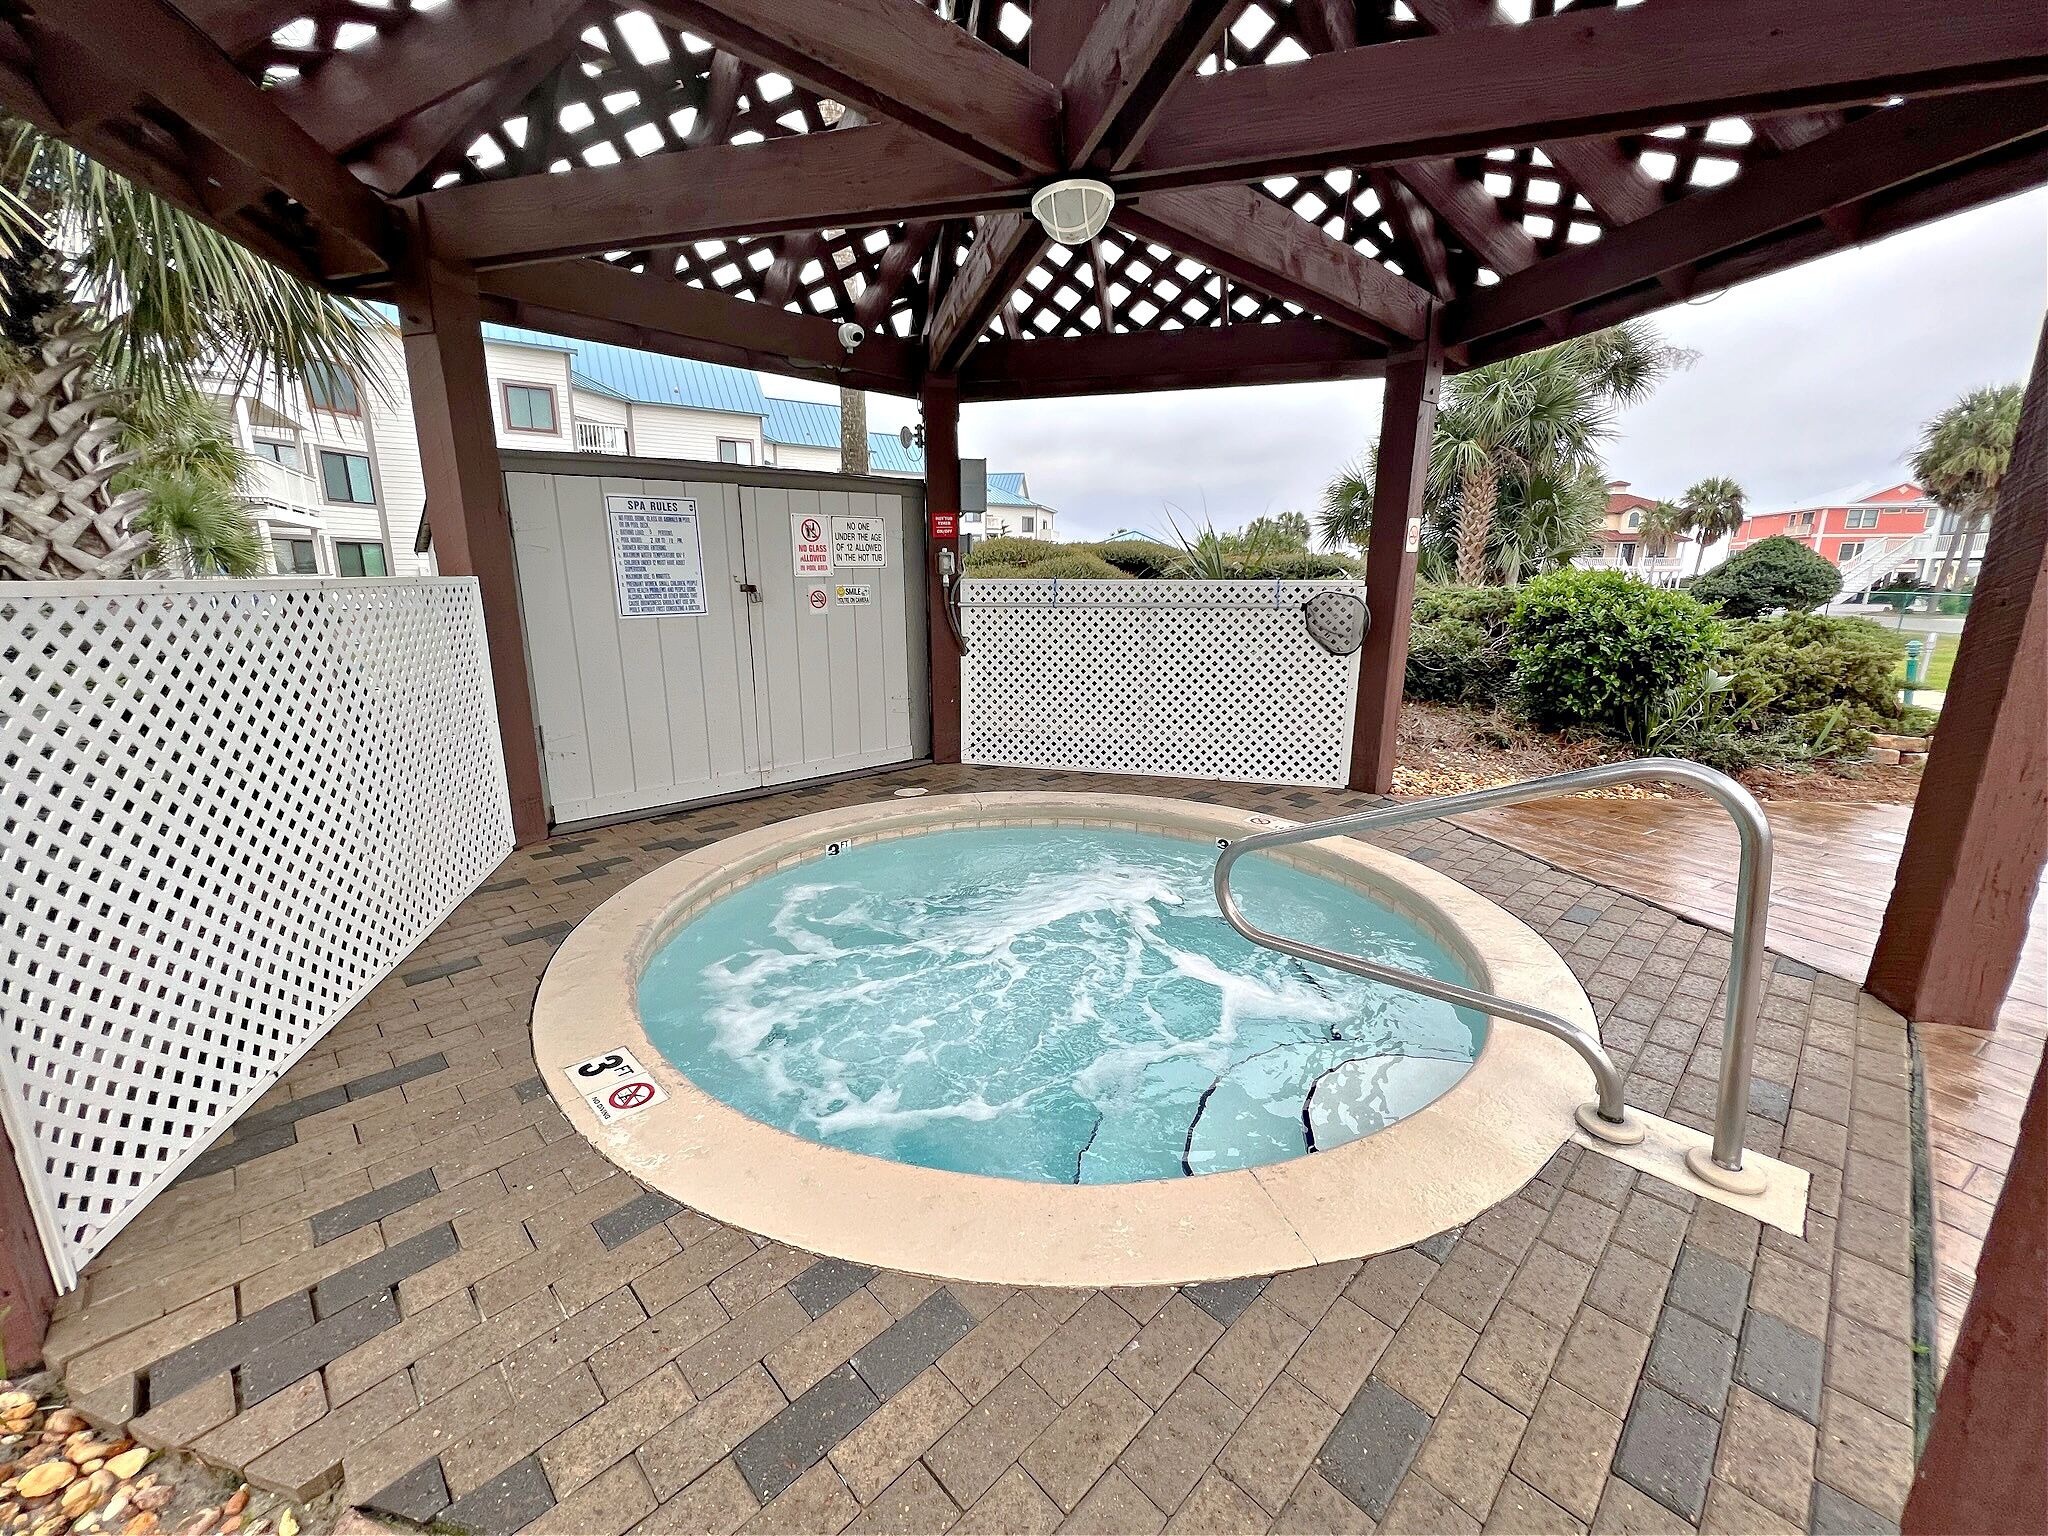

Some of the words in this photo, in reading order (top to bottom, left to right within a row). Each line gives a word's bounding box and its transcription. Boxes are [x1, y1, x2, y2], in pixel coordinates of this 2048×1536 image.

[627, 501, 646, 510] SPA
[650, 502, 678, 511] RULES
[846, 522, 855, 530] NO
[858, 522, 870, 530] ONE
[828, 844, 840, 855] 3
[578, 1055, 623, 1076] 3
[614, 1065, 634, 1076] FT
[591, 1096, 600, 1104] NO
[596, 1104, 611, 1120] DIVING
